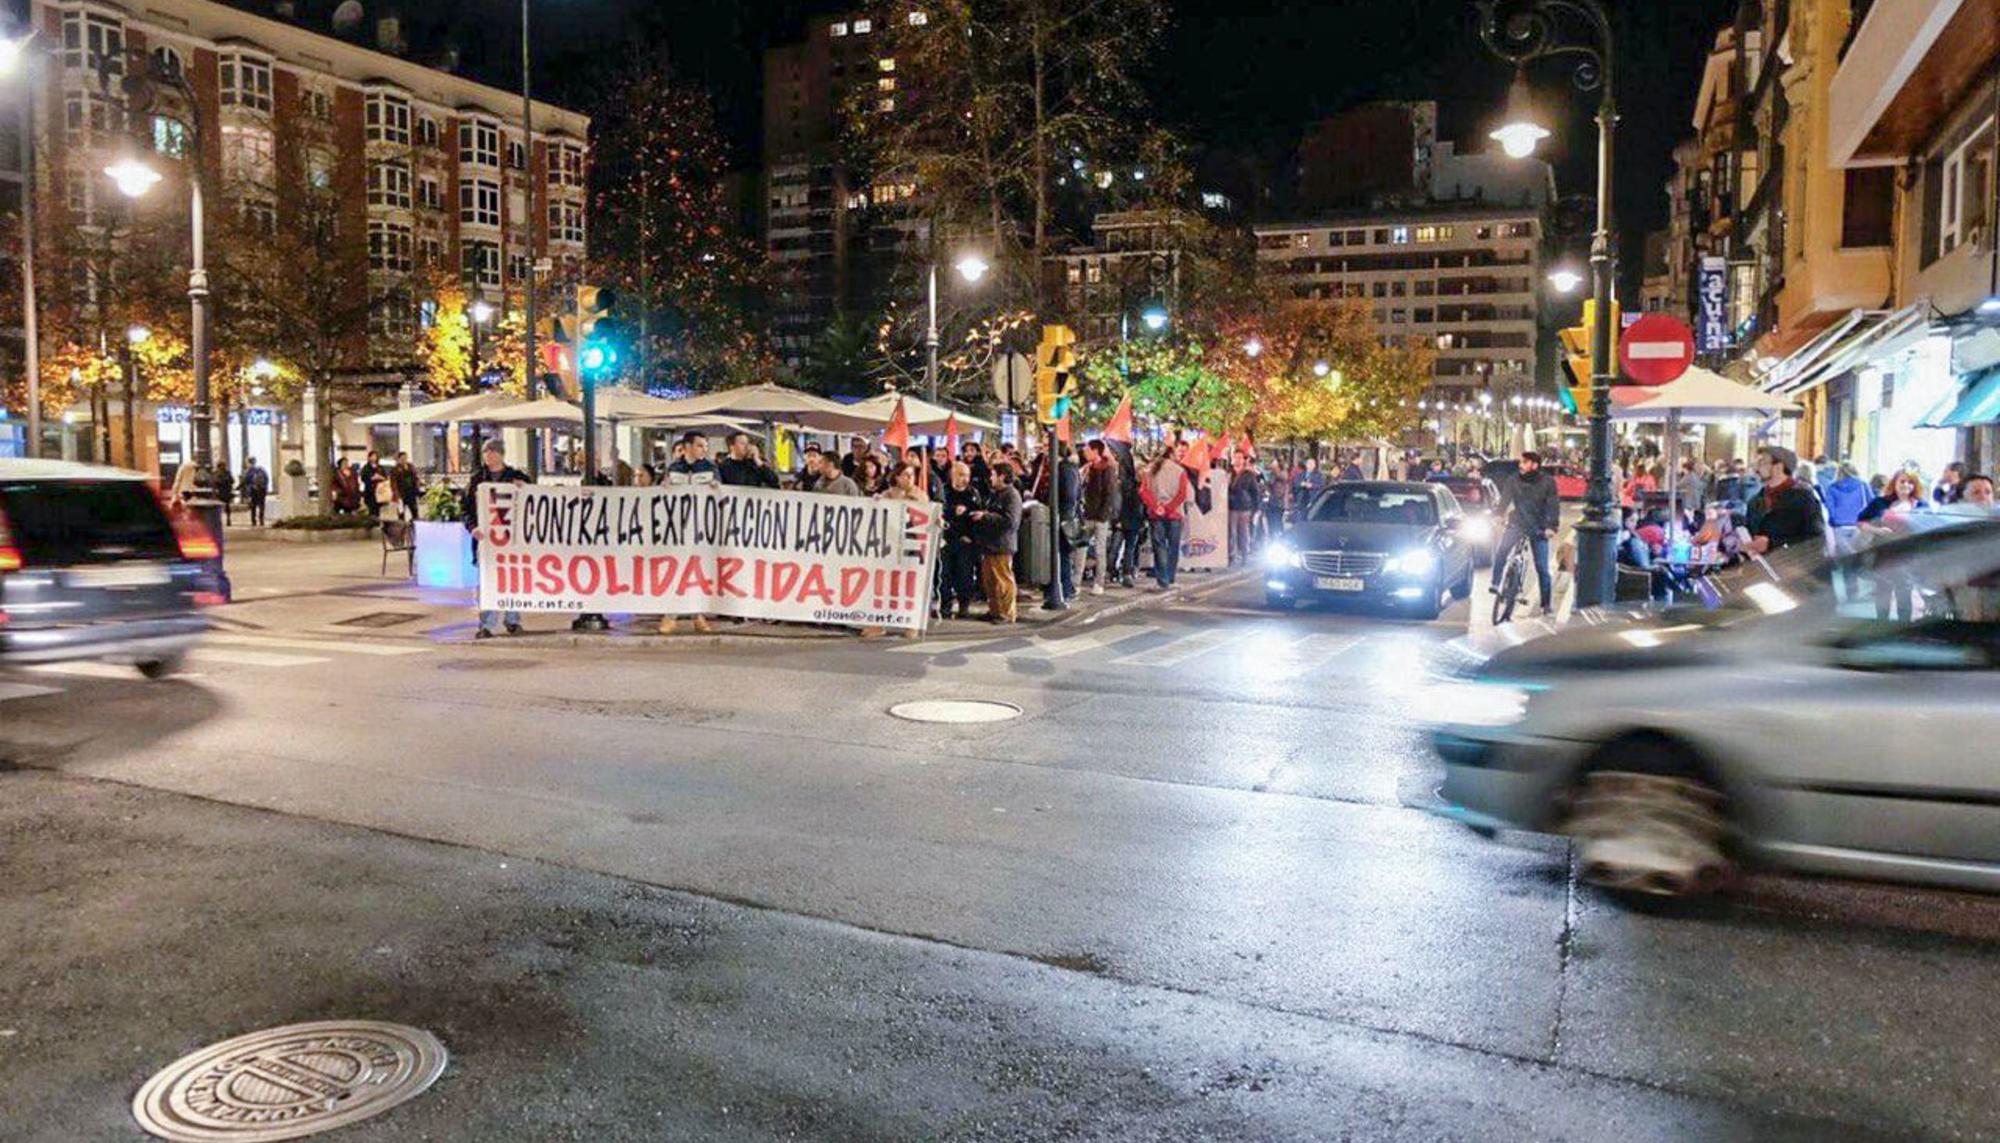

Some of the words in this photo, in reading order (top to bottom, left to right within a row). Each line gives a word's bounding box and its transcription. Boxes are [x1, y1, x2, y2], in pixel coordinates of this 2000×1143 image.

[489, 487, 512, 547] CNT
[523, 494, 609, 546] CONTRA
[617, 496, 643, 546] LA
[794, 501, 891, 558] LABORAL
[903, 506, 929, 565] AIT
